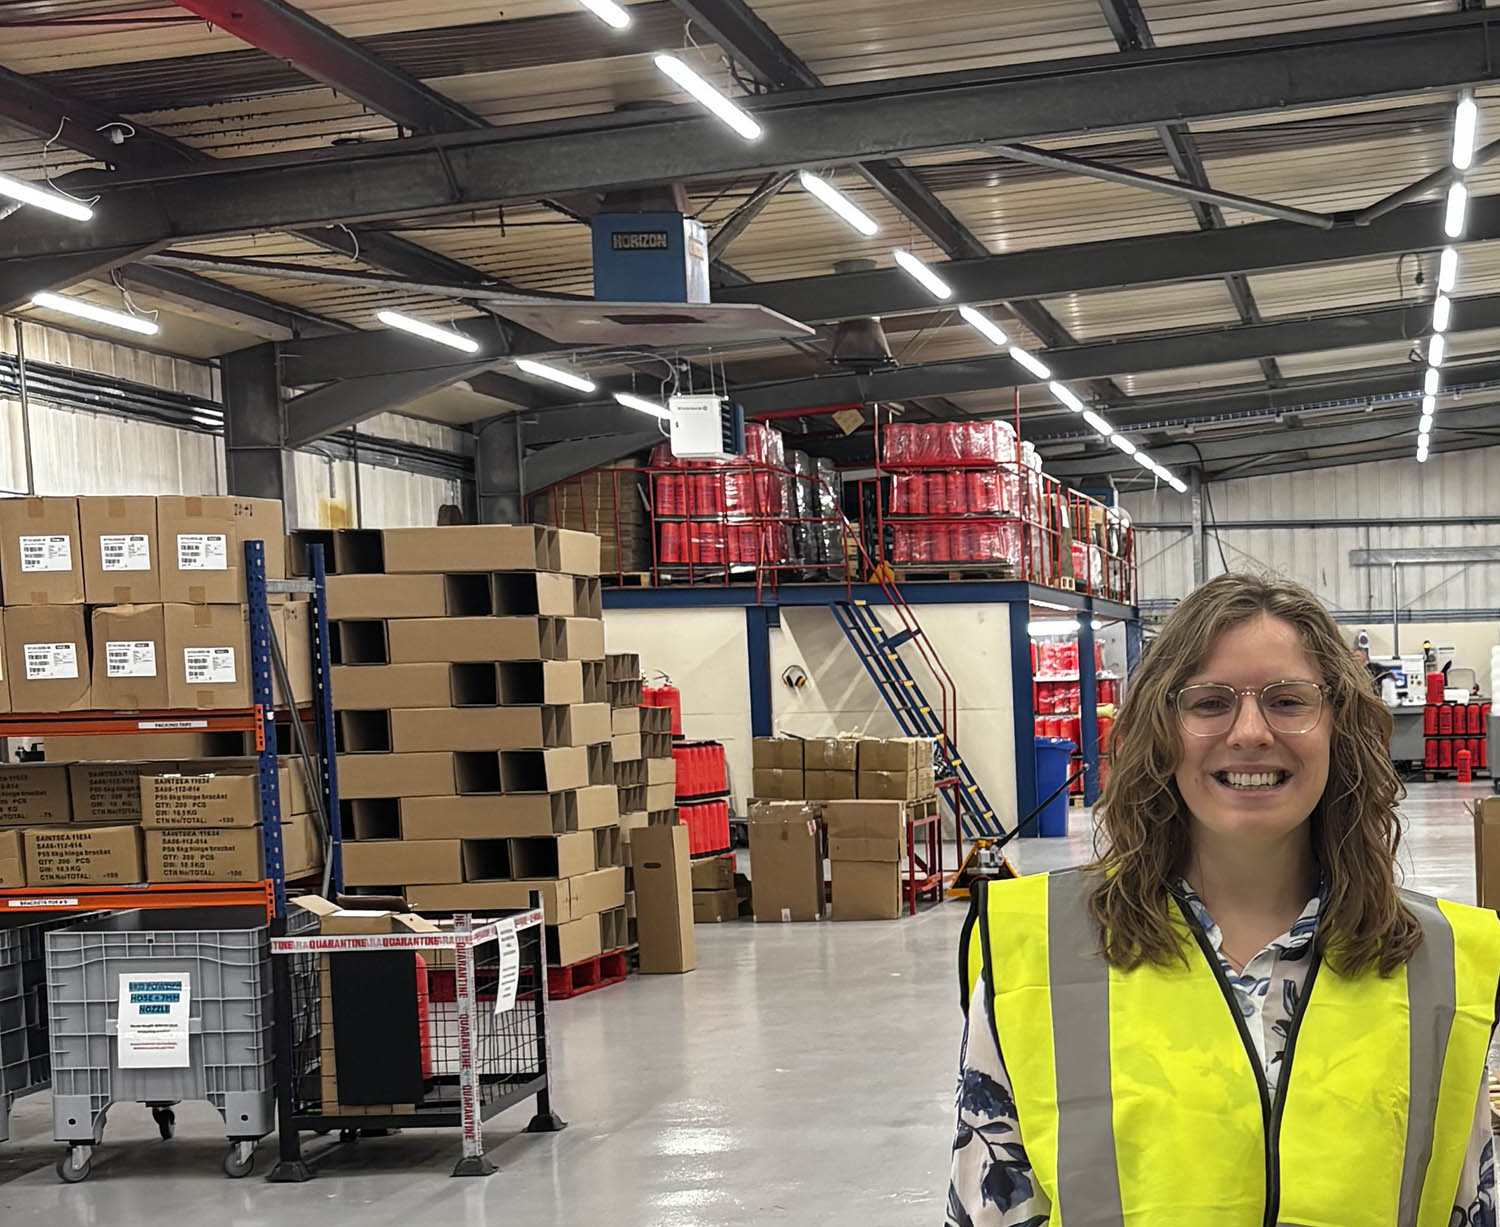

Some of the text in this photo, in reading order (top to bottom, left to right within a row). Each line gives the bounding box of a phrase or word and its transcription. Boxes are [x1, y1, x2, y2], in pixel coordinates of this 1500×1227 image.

[613, 233, 667, 249] HORIZON
[309, 939, 367, 949] QUARANTINE
[383, 937, 440, 947] QUARANTINE
[456, 942, 467, 999] QUARANTINE
[459, 1013, 470, 1070] QUARANTINE
[463, 1084, 474, 1141] QUARANTINE
